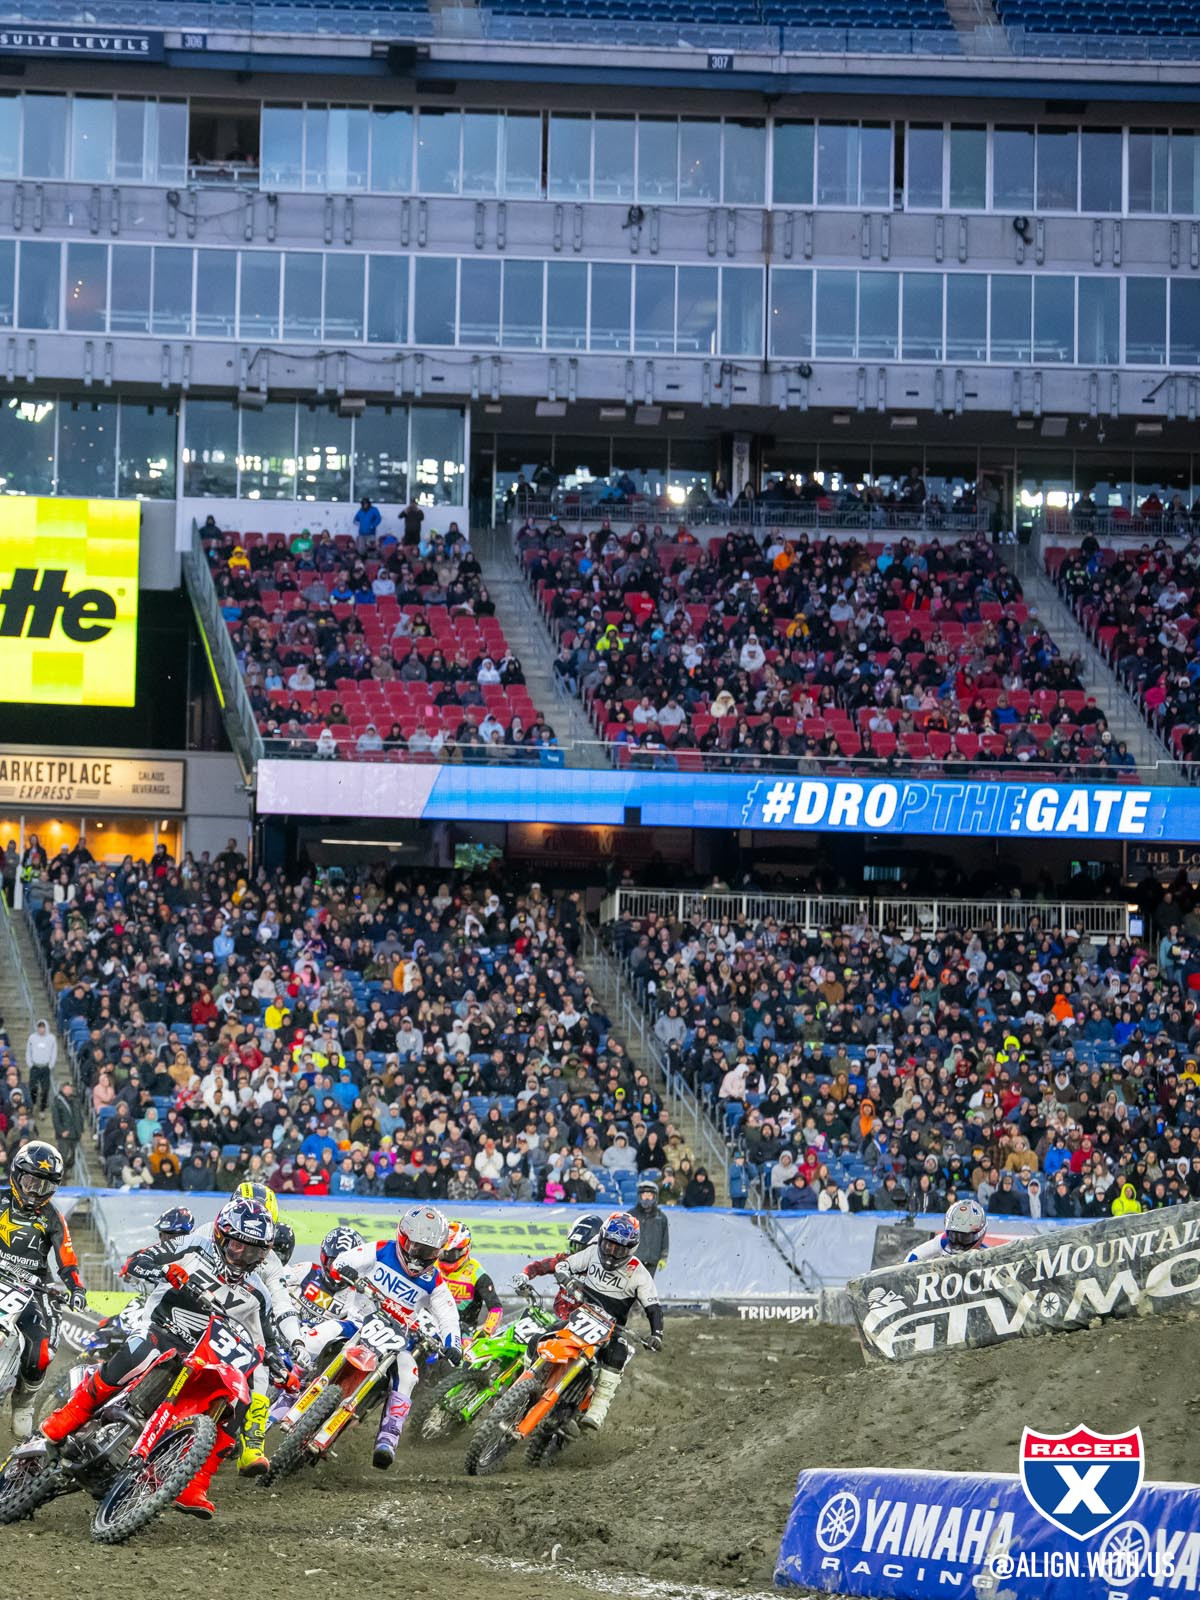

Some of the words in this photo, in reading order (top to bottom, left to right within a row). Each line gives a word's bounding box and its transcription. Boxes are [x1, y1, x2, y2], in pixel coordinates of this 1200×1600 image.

[0, 33, 60, 47] SUITE
[72, 36, 150, 50] LEVELS
[711, 55, 729, 69] 307
[18, 785, 74, 801] EXPRESS
[761, 781, 1153, 834] #DROPTHEGATE
[303, 1282, 344, 1316] FXR
[911, 1261, 1027, 1306] ROCKY
[569, 1311, 609, 1345] 376
[737, 1305, 814, 1323] TRIUMPH
[208, 1326, 251, 1373] 37
[360, 1320, 407, 1351] 602
[861, 1498, 1016, 1565] YAMAHA
[820, 1556, 998, 1590] RACING
